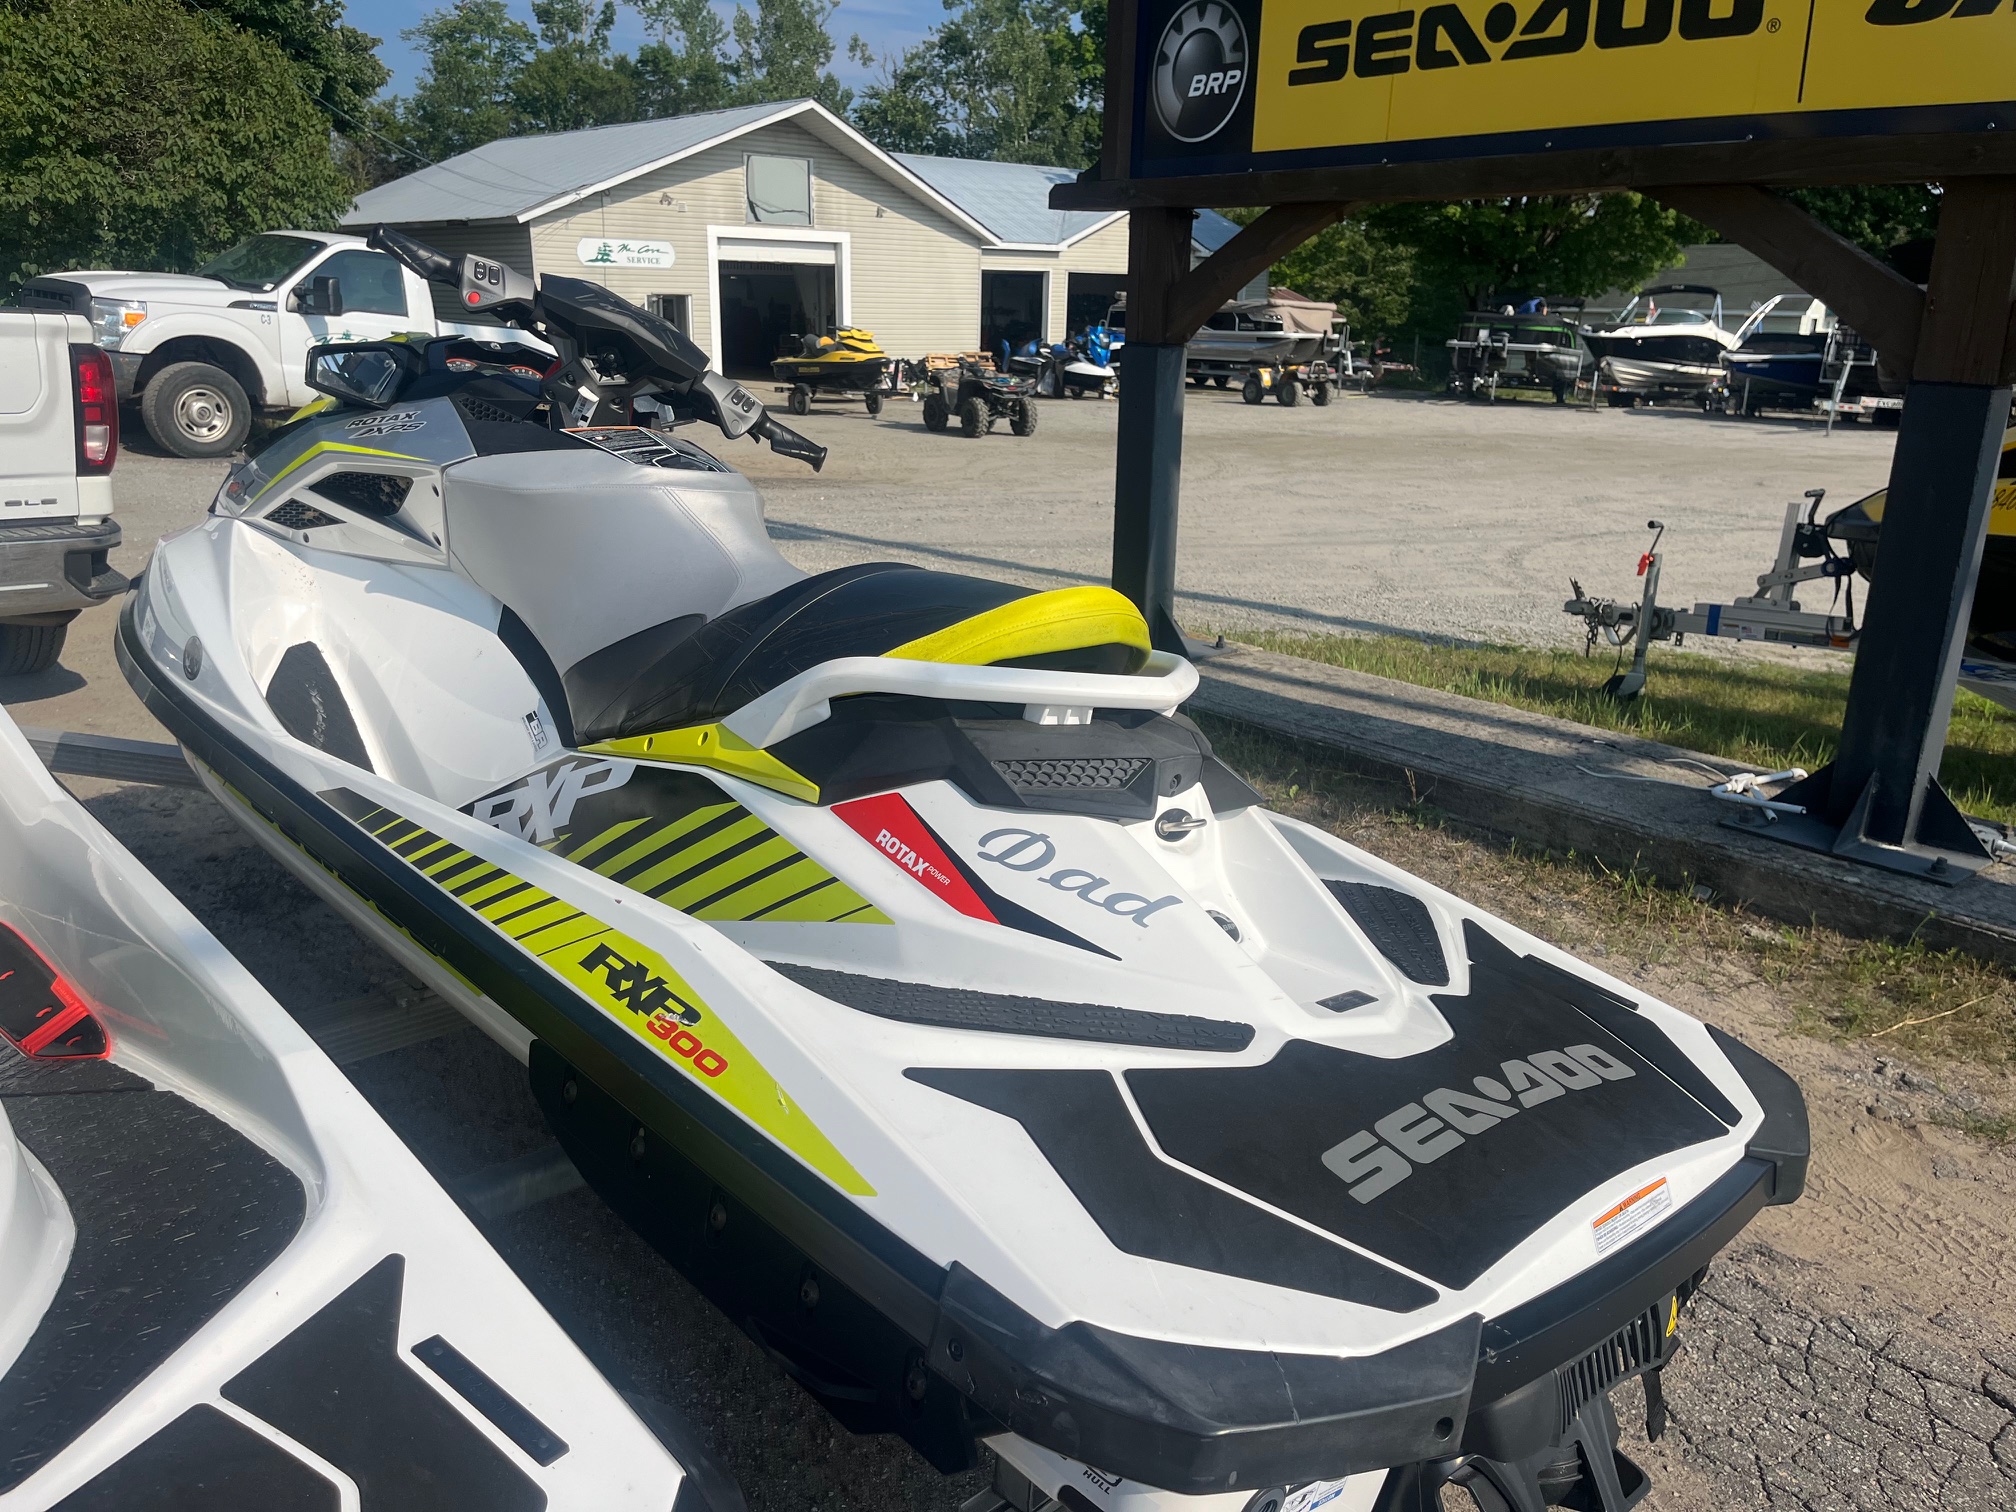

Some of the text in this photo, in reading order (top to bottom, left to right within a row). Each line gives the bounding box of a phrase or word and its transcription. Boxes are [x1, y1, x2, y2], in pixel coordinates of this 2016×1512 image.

[1188, 69, 1242, 98] BRP
[627, 256, 661, 265] SERVICE
[346, 411, 419, 428] ROTAX
[472, 760, 637, 844] RXP
[875, 828, 951, 886] ROTAX POWER
[977, 828, 1184, 929] Dad
[577, 942, 702, 1027] RXP
[646, 1013, 729, 1078] 300
[1082, 1469, 1110, 1495] HULL
